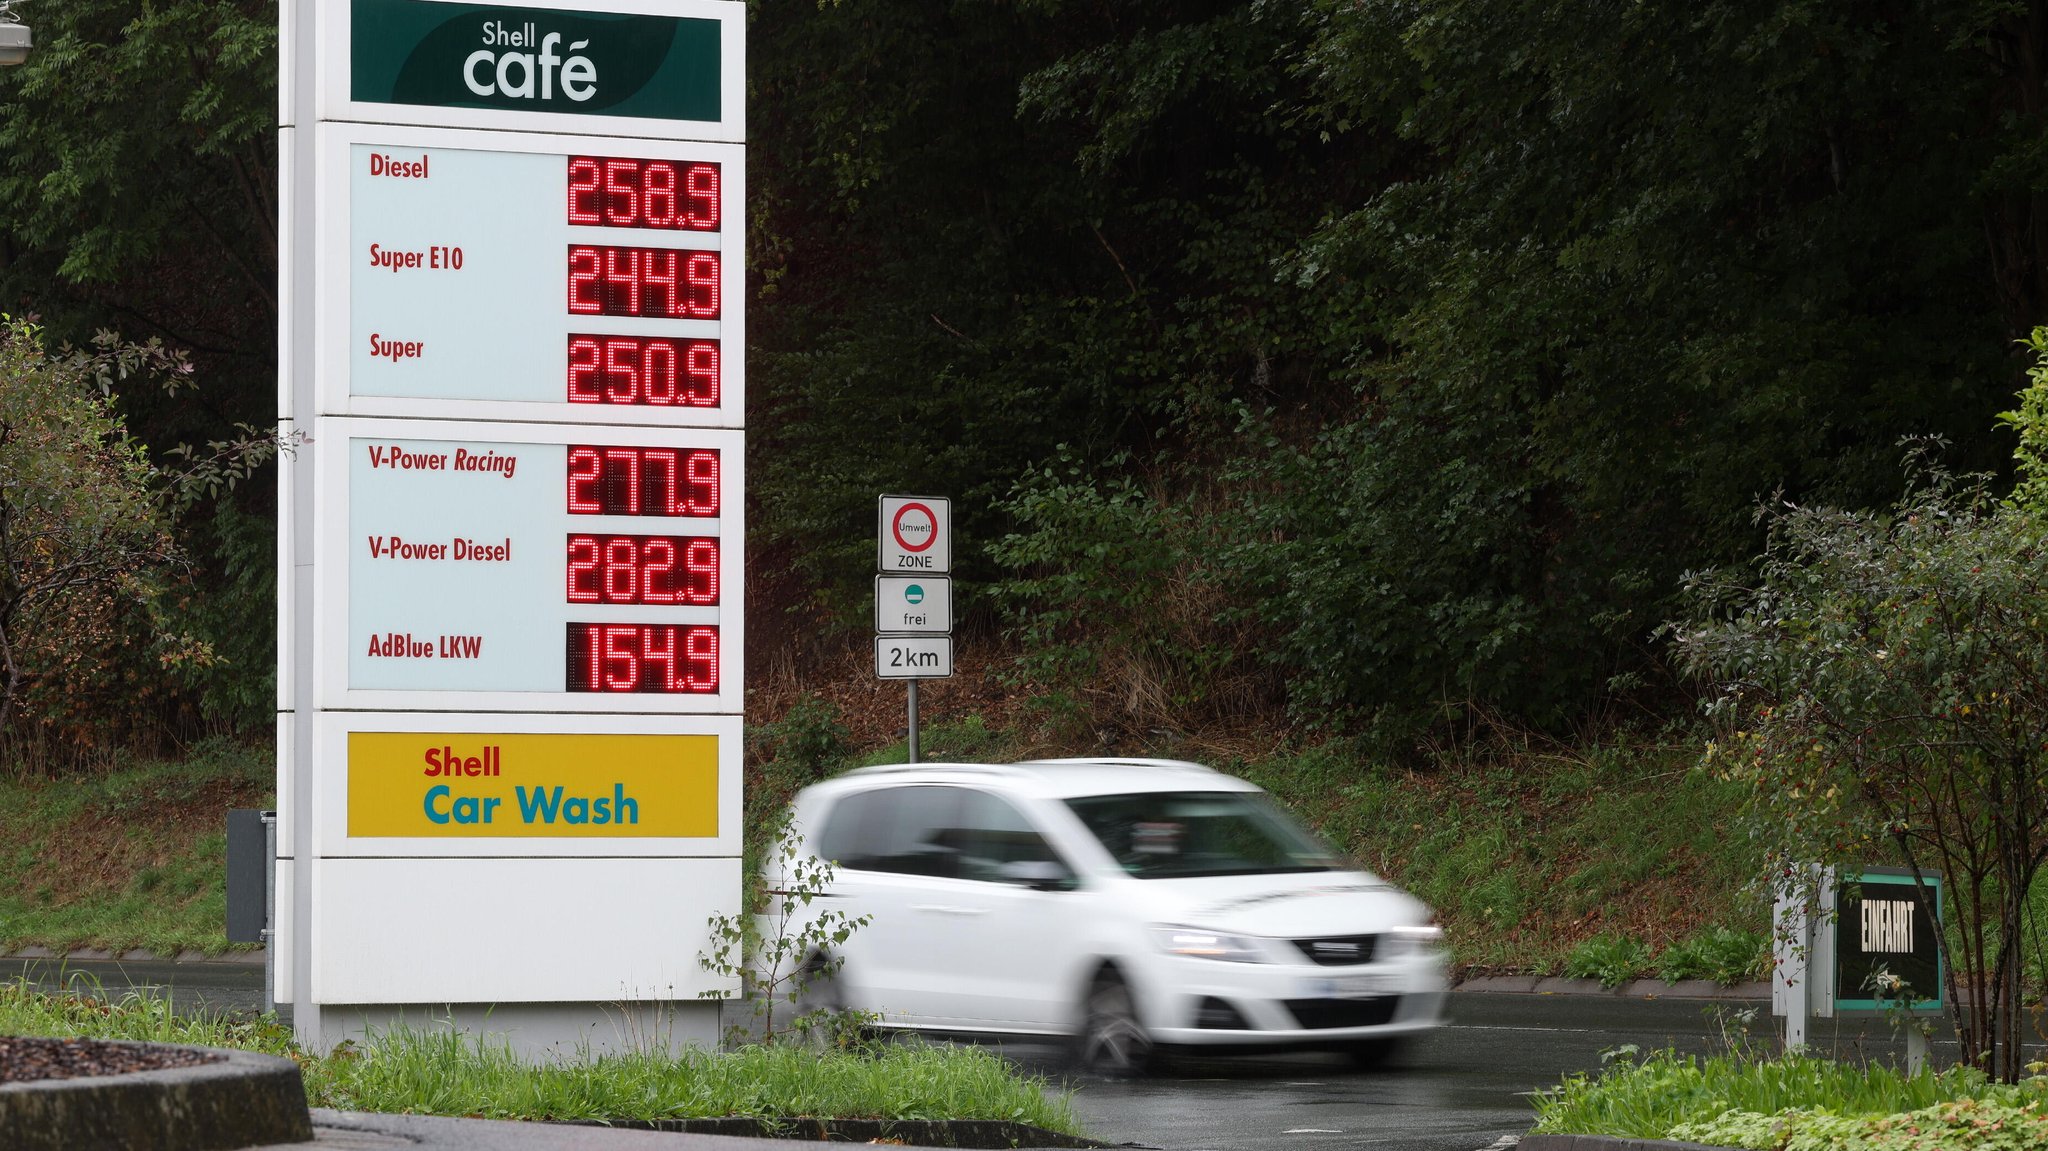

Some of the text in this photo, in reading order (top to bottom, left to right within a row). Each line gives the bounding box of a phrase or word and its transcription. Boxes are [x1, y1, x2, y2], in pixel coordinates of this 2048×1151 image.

[482, 21, 535, 47] Shell
[463, 32, 597, 102] café
[370, 153, 428, 179] Diesel
[569, 159, 718, 228] 258.9
[370, 244, 463, 273] Super E10
[569, 248, 718, 316] 244.9
[370, 333, 423, 363] Super
[569, 339, 718, 405] 250.9
[369, 446, 516, 478] V-Power Racing
[568, 449, 718, 514] 277.9
[900, 523, 931, 532] Umwelt
[369, 536, 510, 561] V-Power Diesel
[898, 555, 932, 567] ZONE
[568, 538, 717, 603] 282.9
[904, 613, 926, 625] frei
[368, 634, 481, 659] AdBlue LKW
[589, 627, 717, 691] 154.9
[424, 746, 500, 777] Shell
[424, 784, 639, 825] Car Wash
[1862, 899, 1914, 953] EINFAHRT
